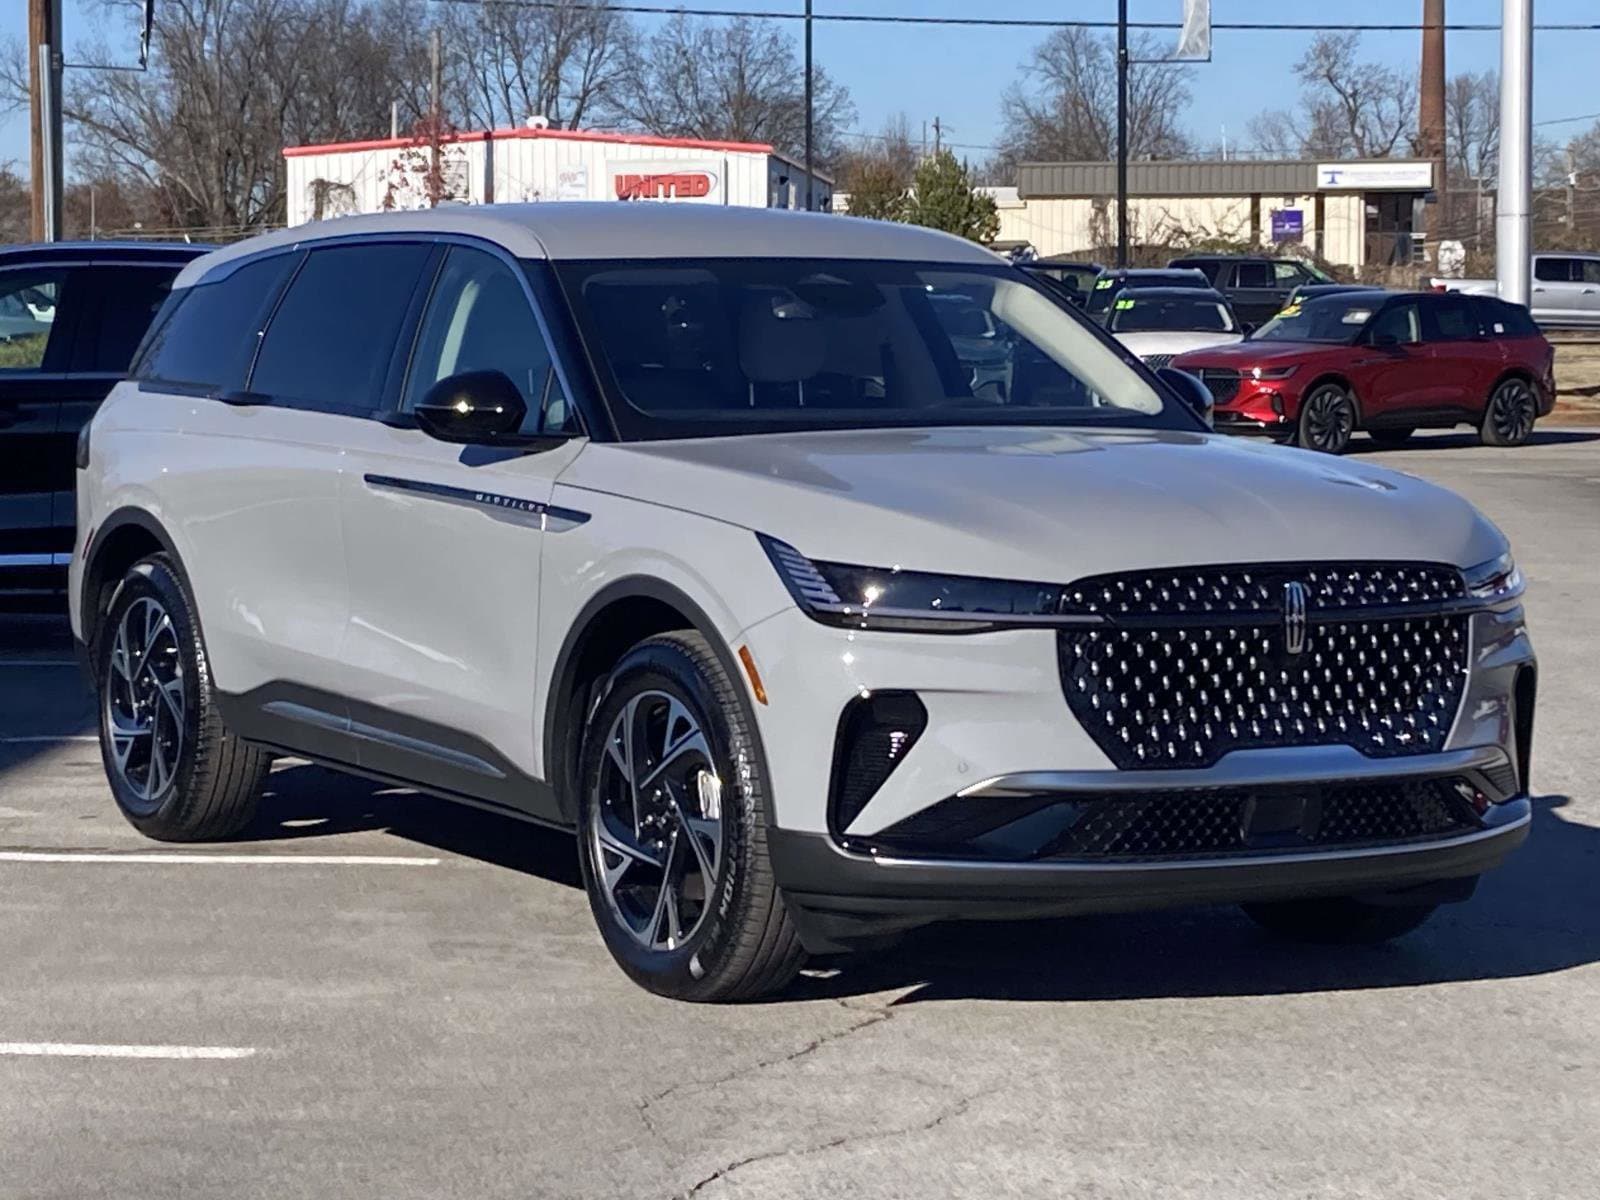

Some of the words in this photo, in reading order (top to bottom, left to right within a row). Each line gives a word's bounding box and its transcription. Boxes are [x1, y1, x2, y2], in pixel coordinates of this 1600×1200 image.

[614, 174, 710, 200] UNITED
[475, 493, 545, 513] NAUTILUS
[718, 788, 740, 921] CORPION
